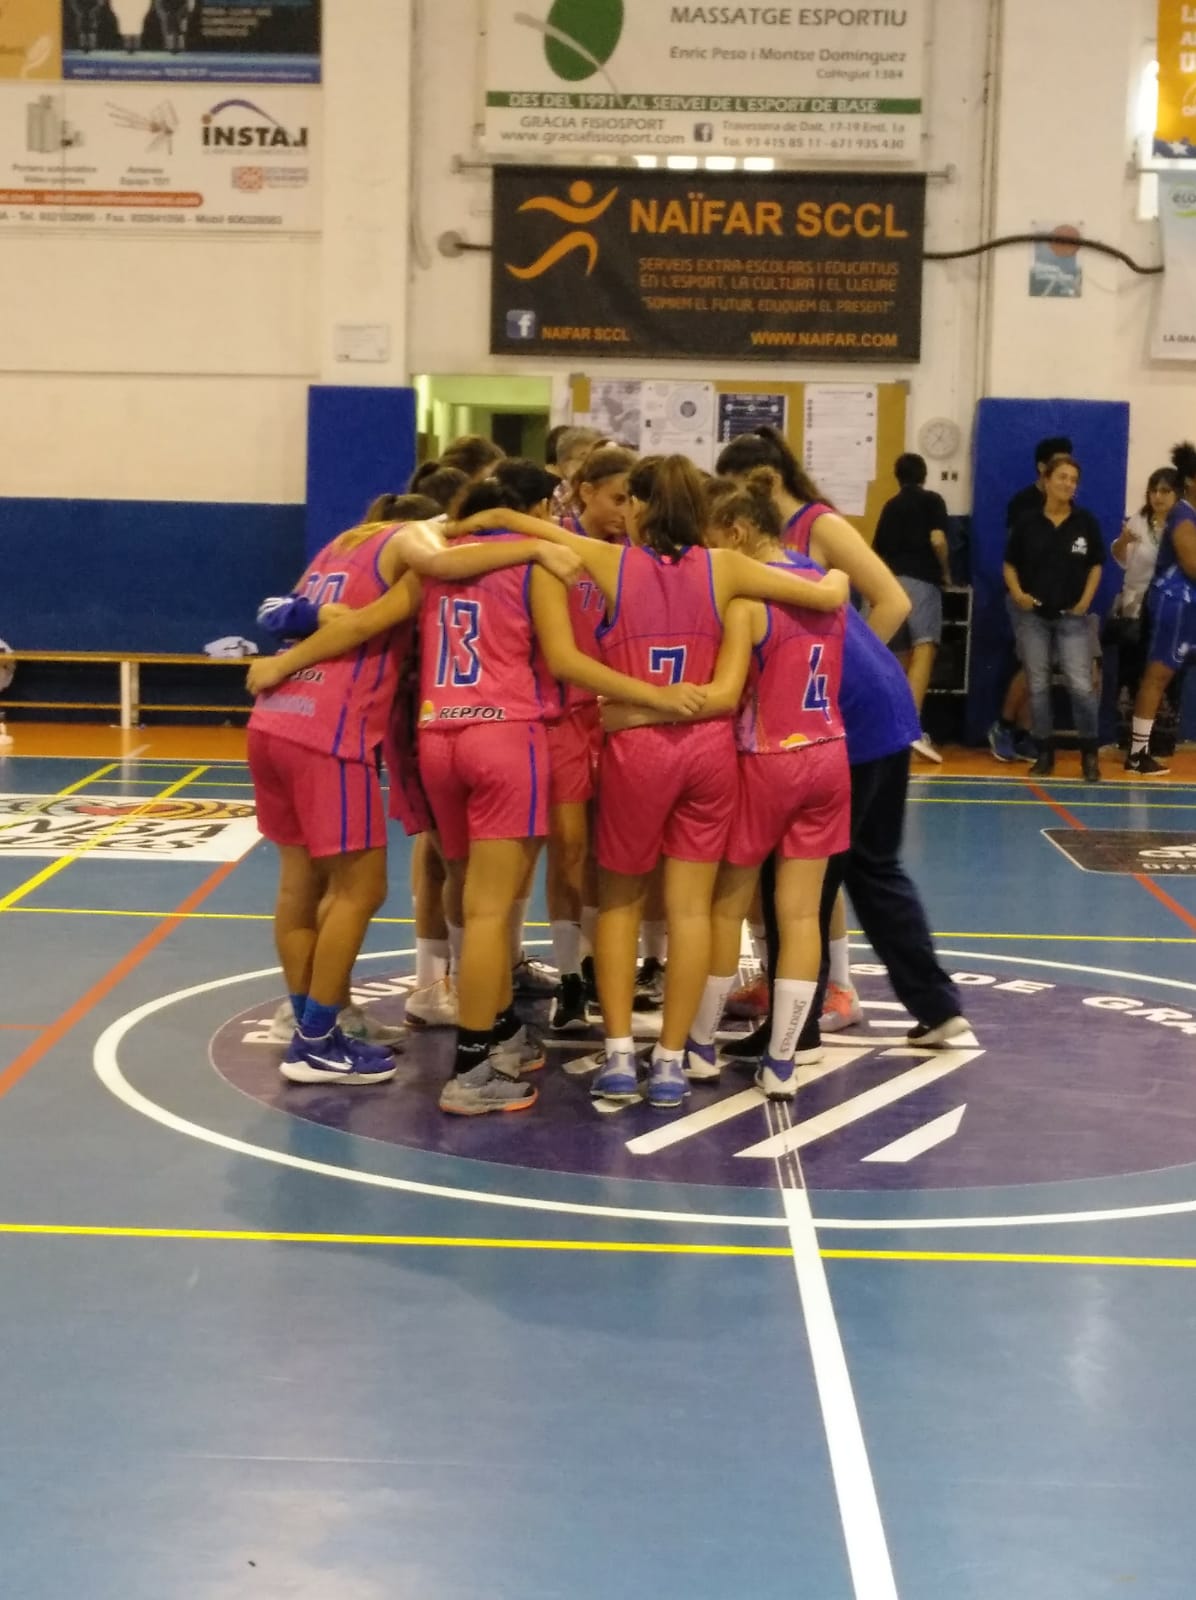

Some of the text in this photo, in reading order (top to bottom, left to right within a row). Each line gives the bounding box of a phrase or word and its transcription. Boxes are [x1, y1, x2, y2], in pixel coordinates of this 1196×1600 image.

[670, 7, 907, 26] MASSATGE ESPORTIU
[669, 47, 707, 59] Enric
[712, 48, 747, 60] Peso
[760, 48, 815, 61] Montse
[509, 94, 541, 107] DES
[543, 94, 573, 108] DEL
[627, 96, 649, 109] AL
[652, 97, 704, 110] SERVEI
[709, 98, 733, 110] DE
[811, 99, 833, 112] DE
[837, 100, 878, 113] BASE
[581, 117, 664, 130] FISIOSPORT
[630, 192, 908, 237] NAÏFAR SCCL
[639, 257, 692, 272] SERVEIS
[541, 327, 630, 342] NAIFAR SCCL
[751, 331, 897, 347] WWW.NAIFAR.COM
[434, 596, 481, 687] 13
[649, 645, 687, 686] 7
[802, 643, 832, 725] 4
[439, 705, 506, 720] REPSOL
[950, 971, 1056, 993] DE
